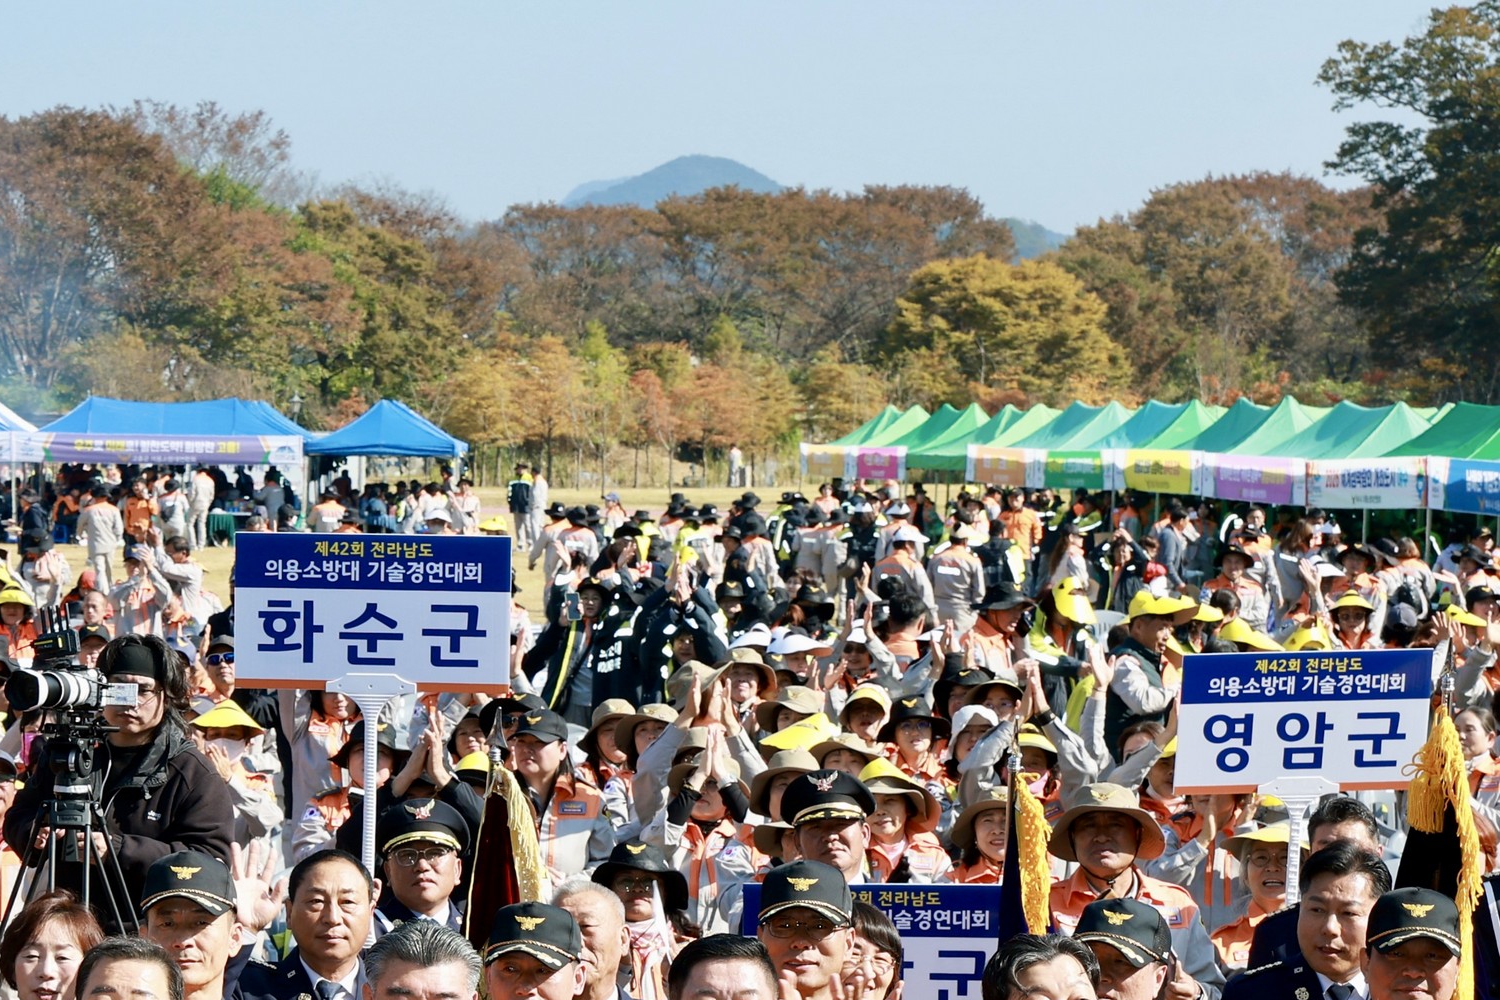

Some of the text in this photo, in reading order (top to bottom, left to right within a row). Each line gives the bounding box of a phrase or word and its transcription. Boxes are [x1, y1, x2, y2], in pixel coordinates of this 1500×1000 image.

[314, 541, 434, 558] 제42회 전라남도
[264, 559, 483, 583] 의용소방대 기술경연대회
[257, 599, 487, 668] 화순군
[1254, 657, 1363, 674] 제42회 전라남도
[1207, 673, 1406, 697] 의용소방대 기술경연대회
[1203, 711, 1407, 773] 영암군
[878, 890, 941, 907] 전라남도
